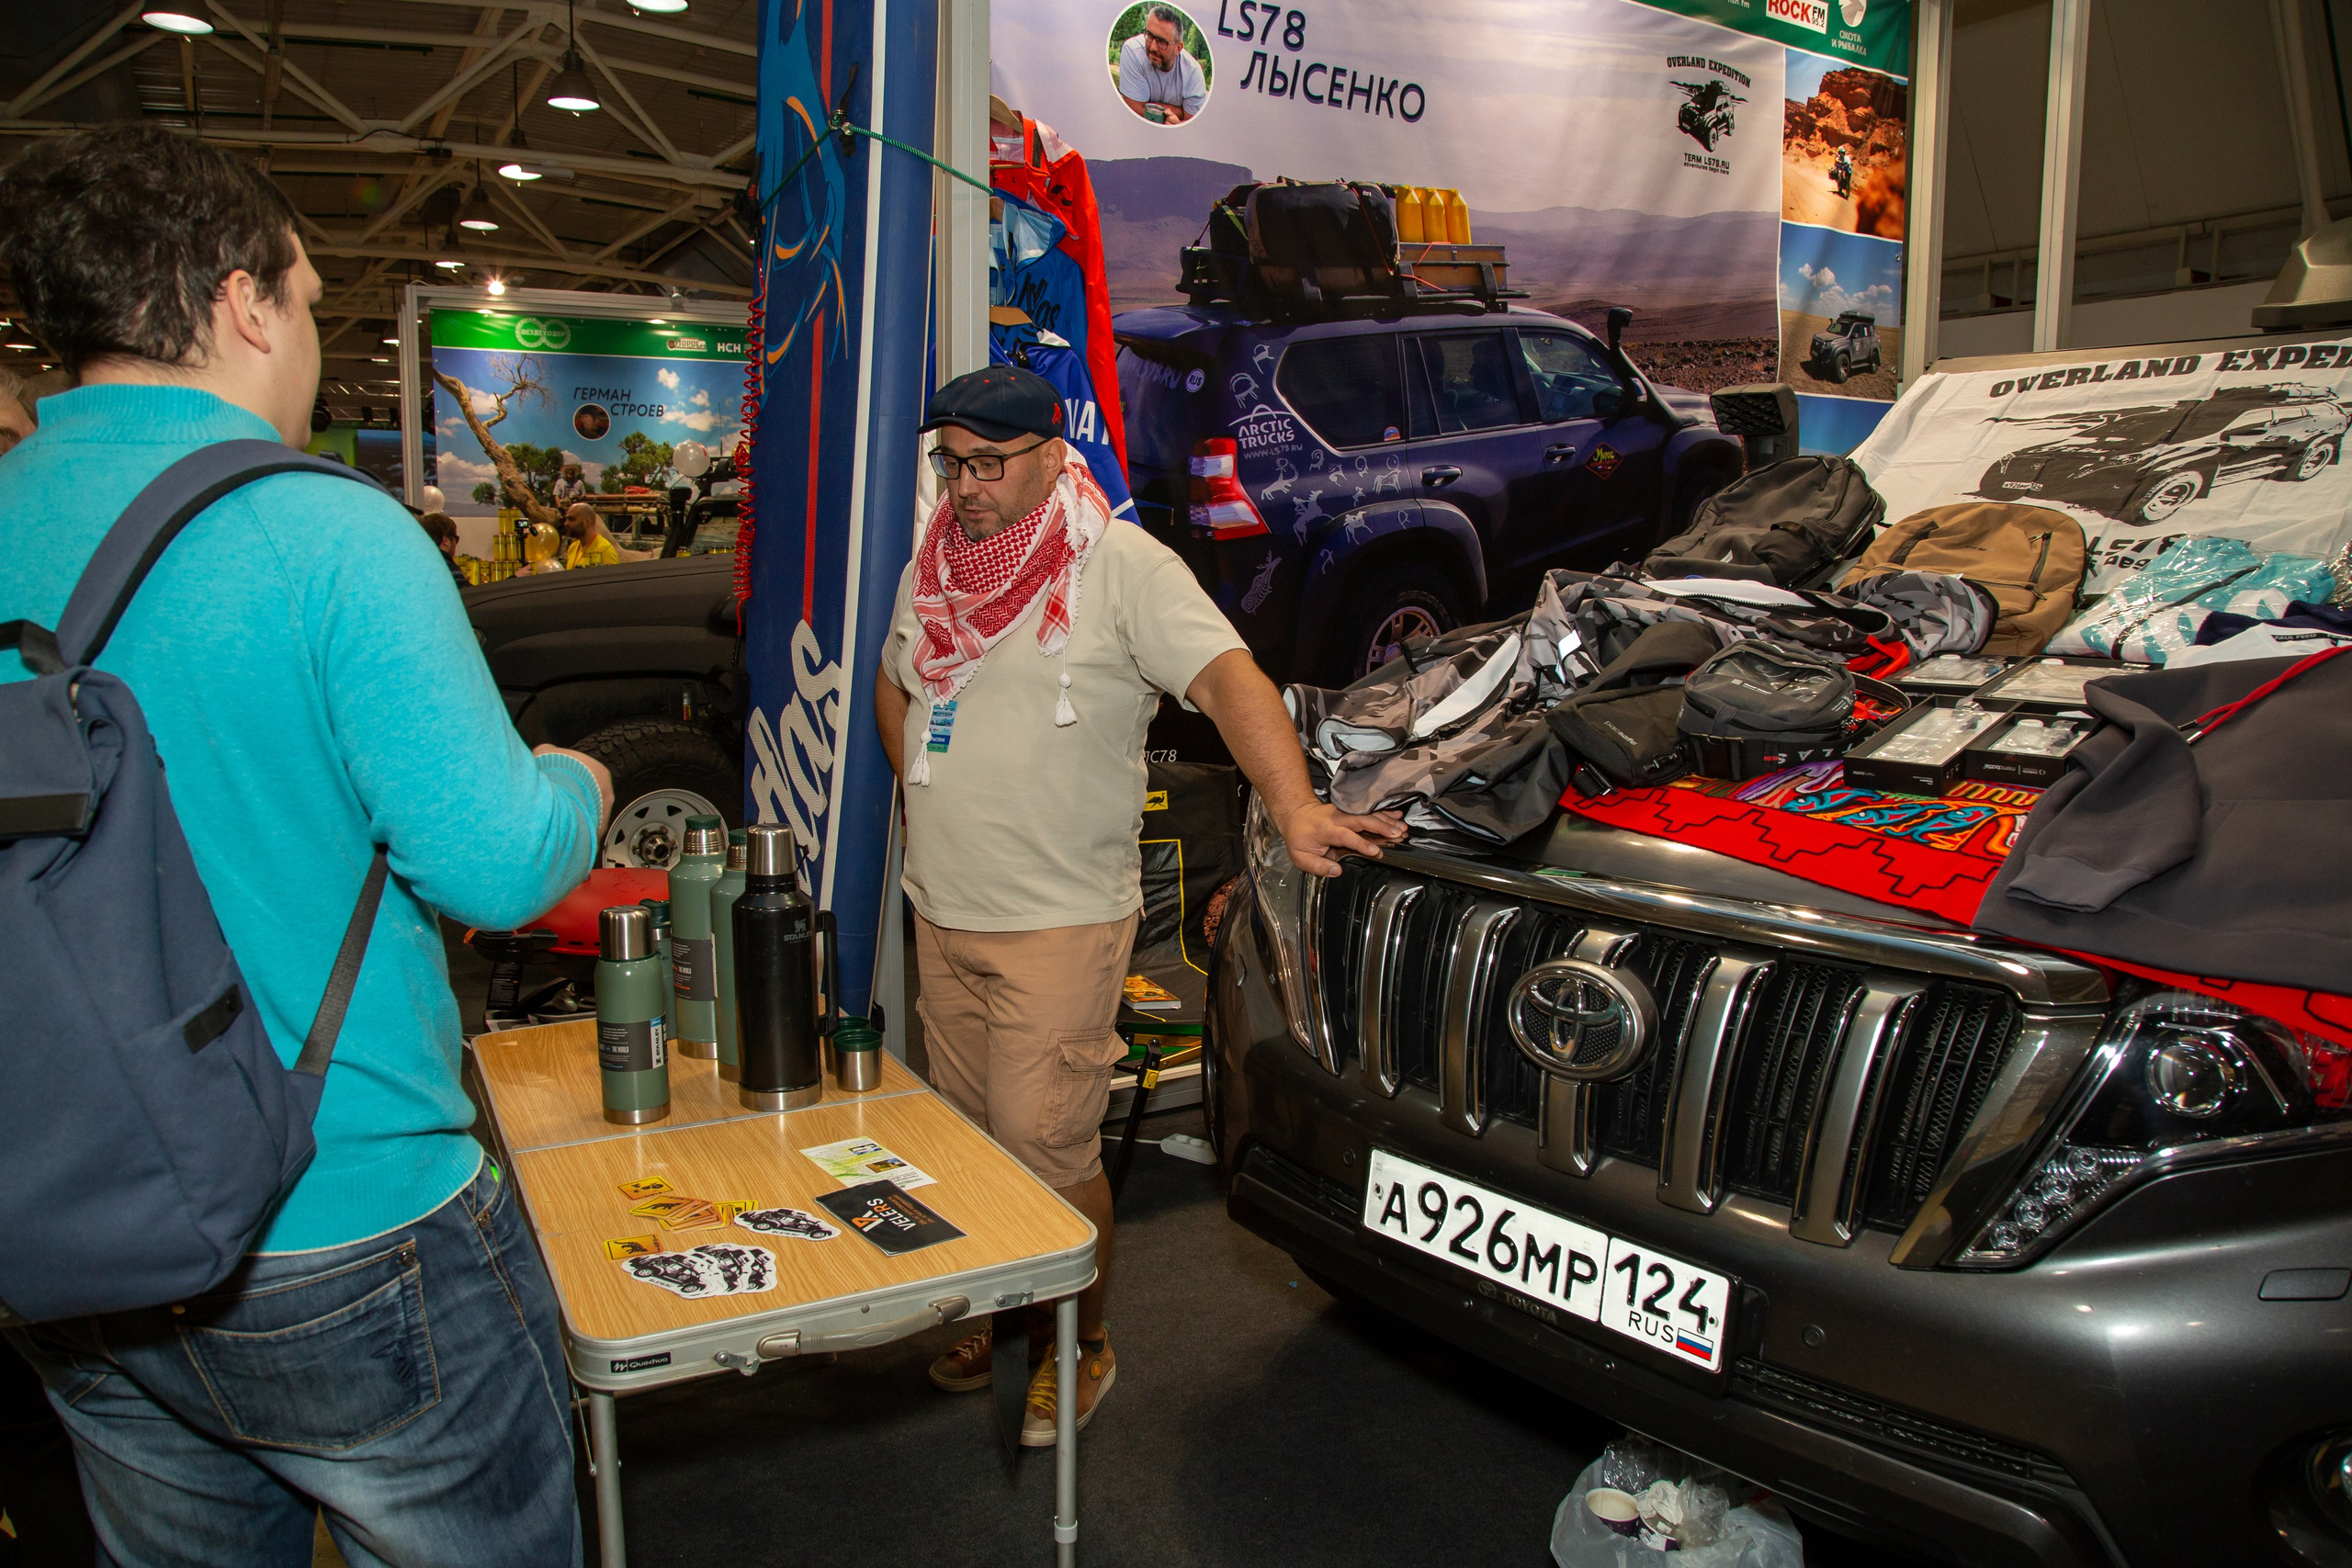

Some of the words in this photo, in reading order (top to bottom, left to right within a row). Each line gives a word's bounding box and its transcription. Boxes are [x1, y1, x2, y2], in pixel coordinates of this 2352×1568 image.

[1768, 0, 1811, 23] ROCK
[1812, 6, 1826, 20] FM
[1217, 0, 1306, 51] LS78
[1811, 17, 1825, 28] 95.2
[1839, 29, 1861, 43] ОХОТА
[1831, 39, 1838, 48] И
[1838, 39, 1867, 56] РЫБАЛКА
[1667, 55, 1706, 69] OVERLAND
[1708, 59, 1751, 88] EXPEDITION
[1240, 51, 1425, 123] ЛЫСЕНКО
[1684, 152, 1702, 164] TEAM
[717, 342, 741, 353] НСН
[1187, 374, 1203, 386] RUS
[1989, 355, 2202, 398] OVERLAND
[573, 387, 631, 401] ГЕРМАН
[610, 402, 664, 417] СТРОЕВ
[1238, 418, 1293, 437] ARCTIC
[1238, 429, 1295, 449] TRUCKS
[783, 930, 812, 942] STANLEY
[866, 1198, 917, 1231] VELERS
[1614, 1253, 1709, 1335] 124
[1504, 1292, 1557, 1324] TOYOTA
[1628, 1310, 1674, 1343] RUS
[629, 1356, 669, 1371] Quechua
